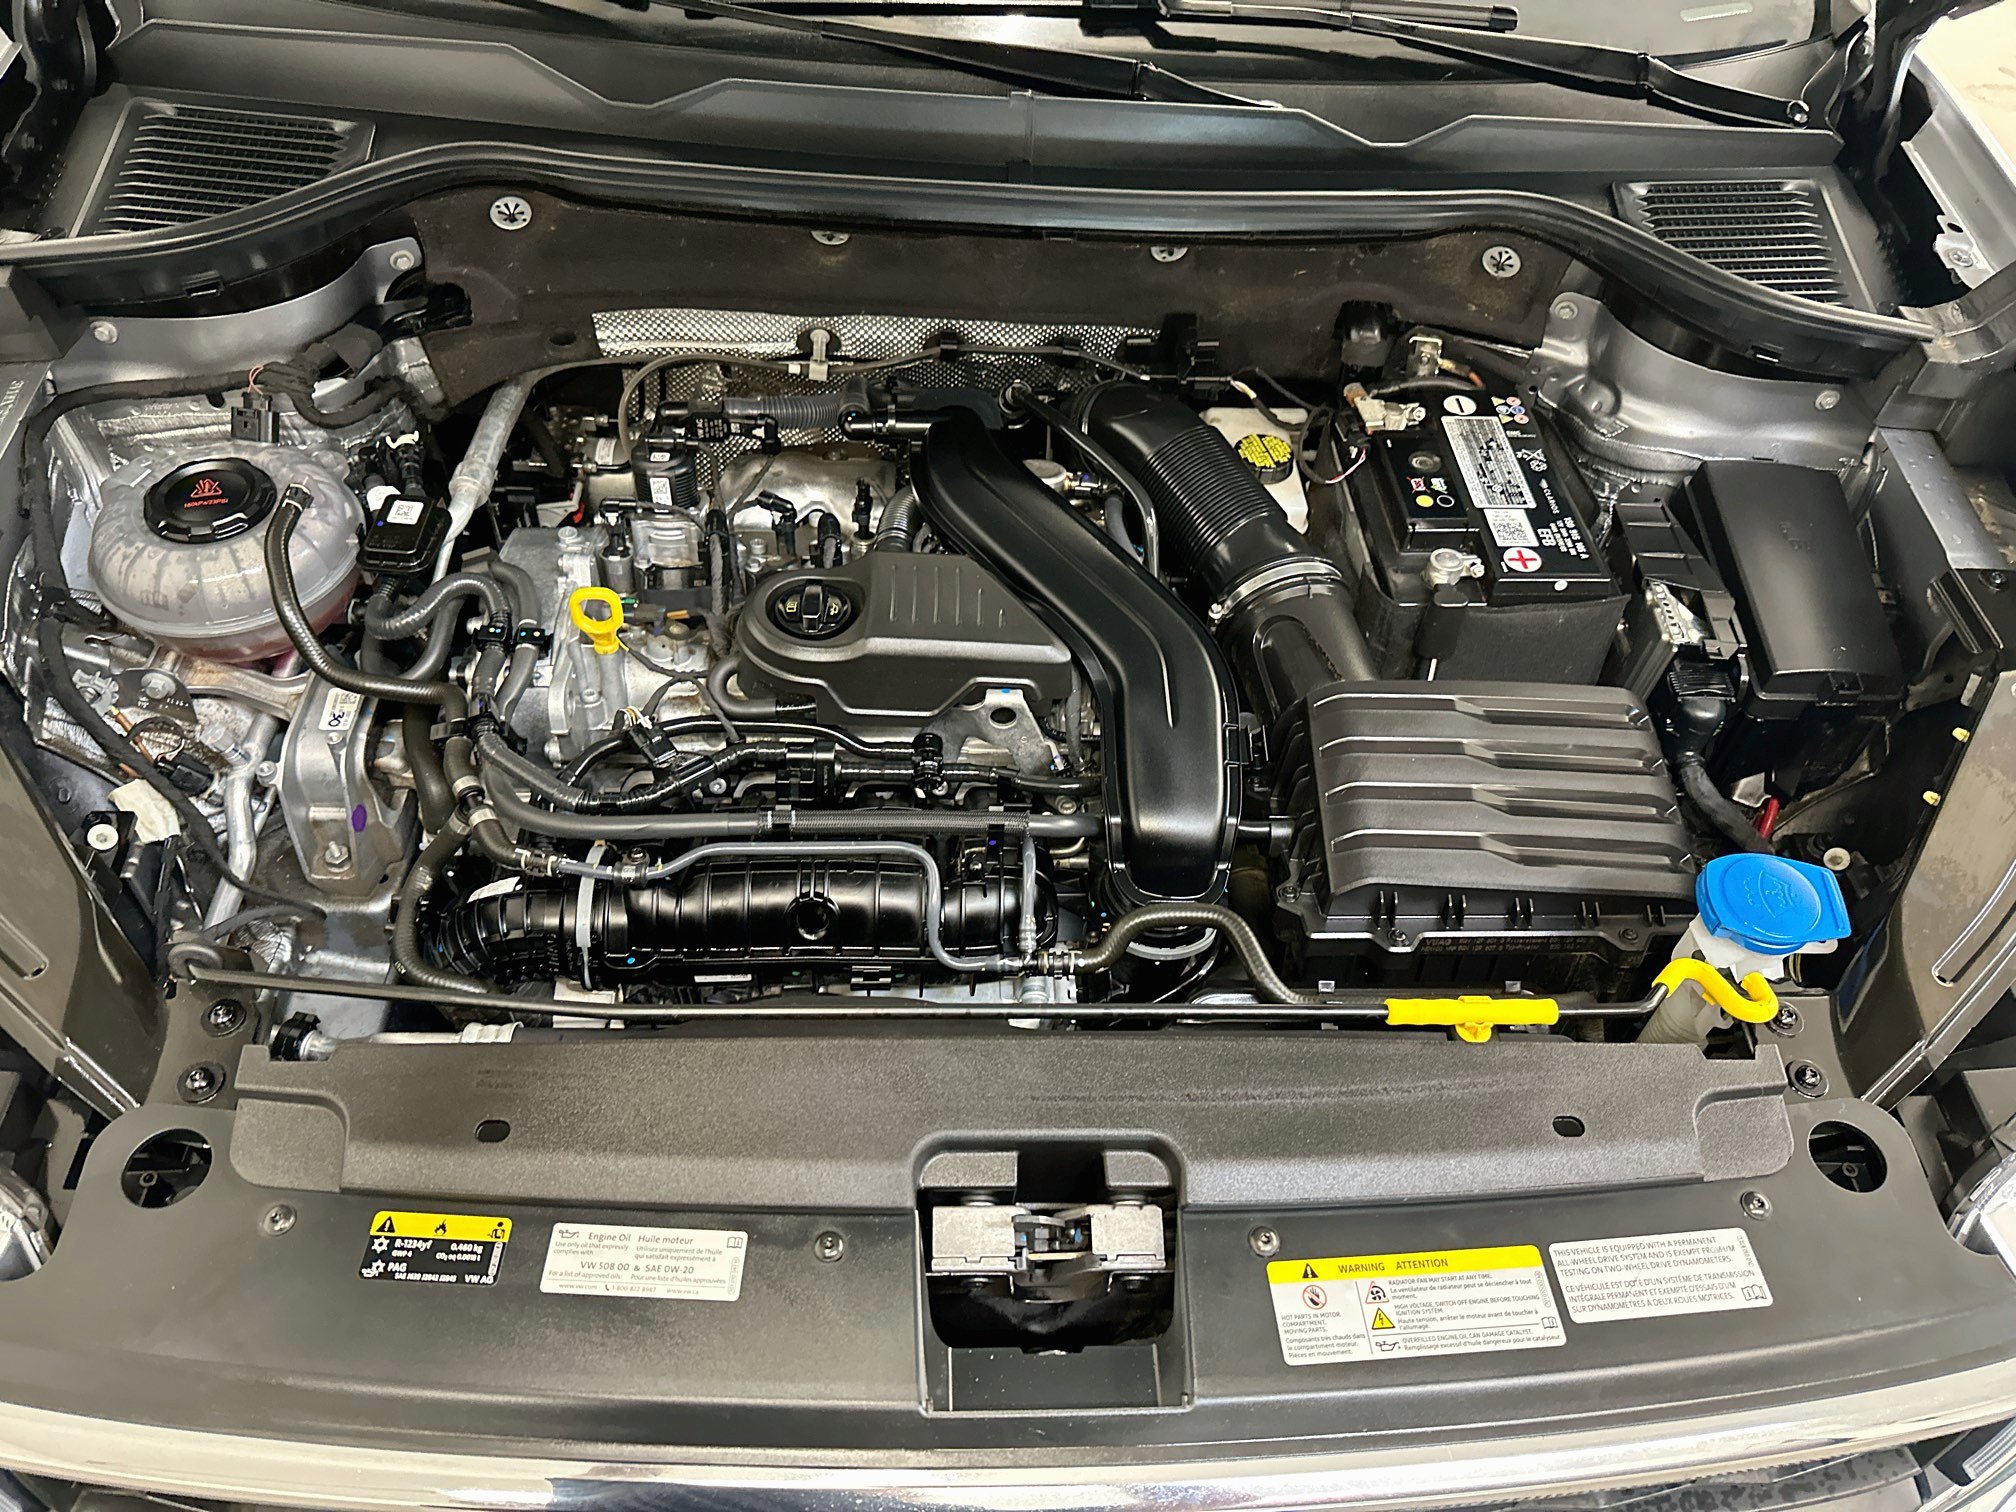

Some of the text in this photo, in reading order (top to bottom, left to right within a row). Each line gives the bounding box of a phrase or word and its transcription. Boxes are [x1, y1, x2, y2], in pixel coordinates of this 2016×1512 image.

[1543, 488, 1560, 514] CLARIOS
[1537, 528, 1557, 546] EFB
[588, 1232, 632, 1242] Engine Oil
[638, 1235, 694, 1245] Huile moteur
[394, 1239, 433, 1251] R-1234yf
[451, 1243, 484, 1254] 0.460 kg
[602, 1243, 629, 1251] expressly
[636, 1245, 658, 1253] Utilisez
[1553, 1249, 1570, 1257] THIS
[1570, 1246, 1601, 1255] VEHICLE
[1601, 1245, 1609, 1253] IS
[1609, 1243, 1646, 1253] EQUIPPED
[1646, 1241, 1666, 1249] WITH
[1674, 1236, 1716, 1247] PERMANENT
[1557, 1257, 1597, 1267] ALL-WHEEL
[1597, 1255, 1620, 1263] DRIVE
[1620, 1252, 1647, 1261] SYSTEM
[1648, 1251, 1665, 1259] AND
[1673, 1247, 1700, 1257] EXEMPT
[387, 1262, 408, 1272] PAG
[580, 1261, 597, 1269] VW
[599, 1262, 615, 1270] 508
[617, 1263, 630, 1271] 00
[645, 1264, 662, 1272] SAE
[664, 1265, 695, 1274] 0W-20
[1338, 1258, 1449, 1274] WARNING ATTENTION
[1560, 1255, 1734, 1276] TESTING ON TWO-WHEEL DRIVE DYNAMOMETERS.
[394, 1272, 406, 1280] SAE
[464, 1274, 494, 1284] VW AG
[693, 1277, 726, 1285] approuvées
[1565, 1269, 1755, 1293] CE VÉHICULE EST D'UN SYSTÈME DE TRANSMISSION
[1388, 1278, 1416, 1286] RADIATOR
[1398, 1285, 1428, 1293] ventilateur
[1484, 1279, 1514, 1287] déclencher
[1512, 1294, 1540, 1302] TOUCHING
[1568, 1283, 1718, 1303] INTÉGRALE PERMANENT ET EXEMPTÉ D'ESSAIS
[1572, 1305, 1587, 1314] SUR
[1587, 1300, 1646, 1312] DYNAMOMÈTRES
[1646, 1298, 1652, 1306] À
[1653, 1297, 1672, 1306] DEUX
[1674, 1296, 1698, 1304] ROUES
[1282, 1320, 1327, 1328] COMPARTMENT.
[1285, 1336, 1320, 1344] Composants
[1332, 1333, 1352, 1341] chauds
[1402, 1335, 1436, 1343] OVERFILLED
[1481, 1330, 1505, 1338] DAMAGE
[1294, 1343, 1335, 1351] compartiment
[1404, 1343, 1439, 1351] Remplissage
[1483, 1338, 1512, 1346] dangereux
